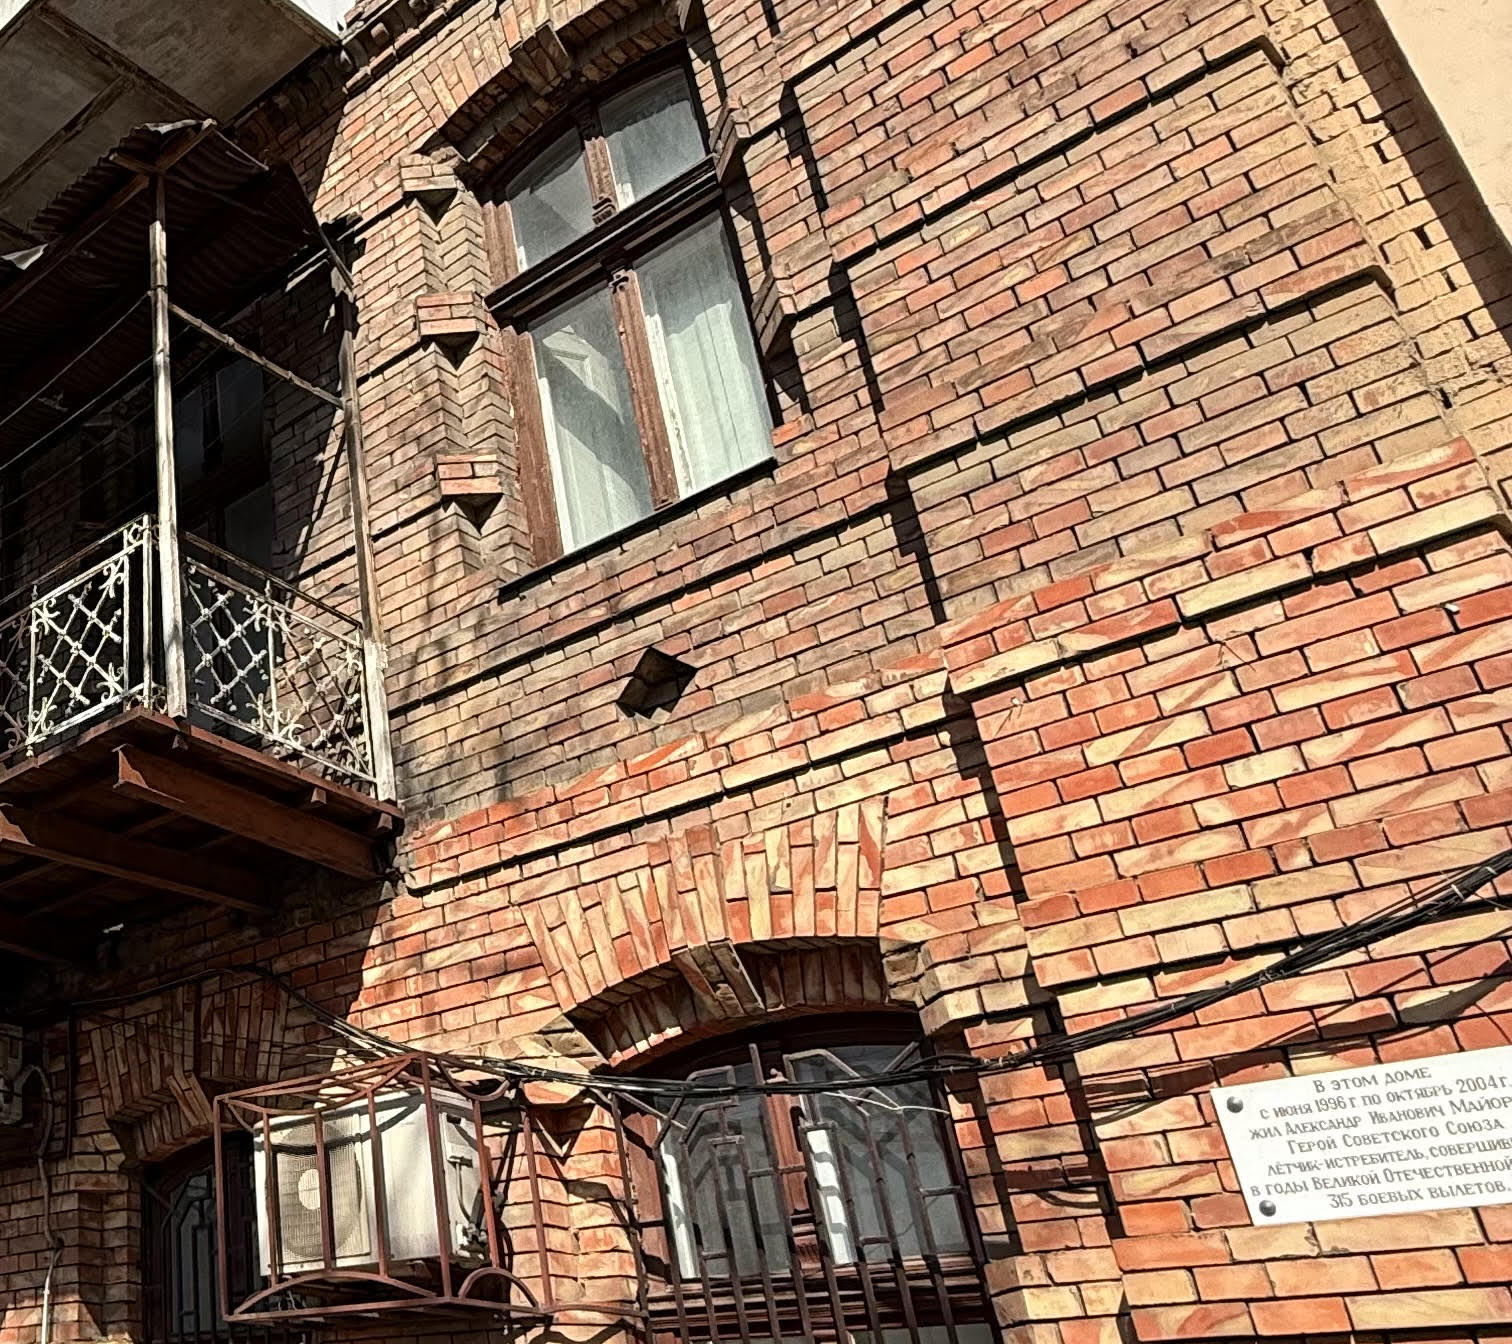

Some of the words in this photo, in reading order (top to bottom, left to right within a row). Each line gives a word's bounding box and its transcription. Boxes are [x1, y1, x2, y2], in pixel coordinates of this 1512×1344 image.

[1313, 1079, 1326, 1093] В
[1314, 1096, 1348, 1113] 1996
[1455, 1074, 1498, 1093] 2004
[1326, 1192, 1354, 1209] 315
